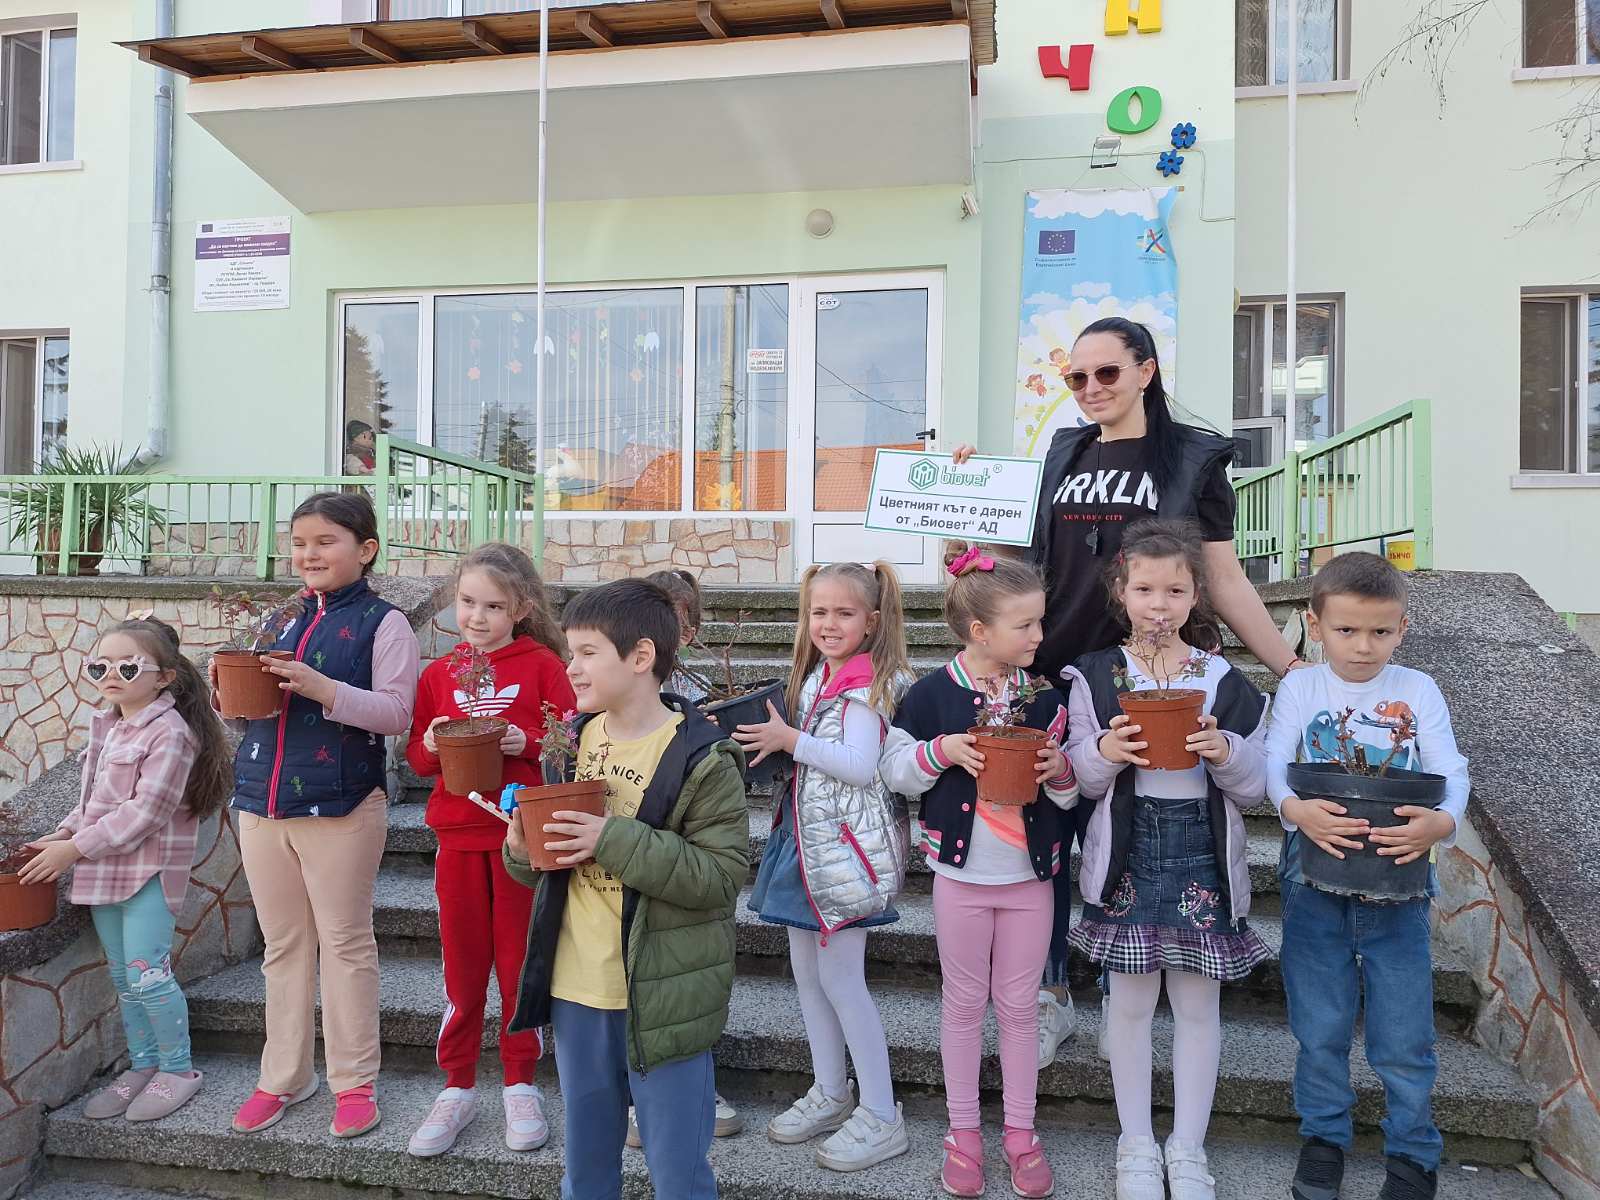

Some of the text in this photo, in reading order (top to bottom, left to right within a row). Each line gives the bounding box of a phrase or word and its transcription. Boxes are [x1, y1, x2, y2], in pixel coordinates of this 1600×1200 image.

[941, 464, 990, 487] biovet
[879, 495, 1022, 519] Цветният кът е дарен
[896, 515, 910, 526] от
[978, 521, 998, 535] АД
[611, 765, 644, 786] NICE
